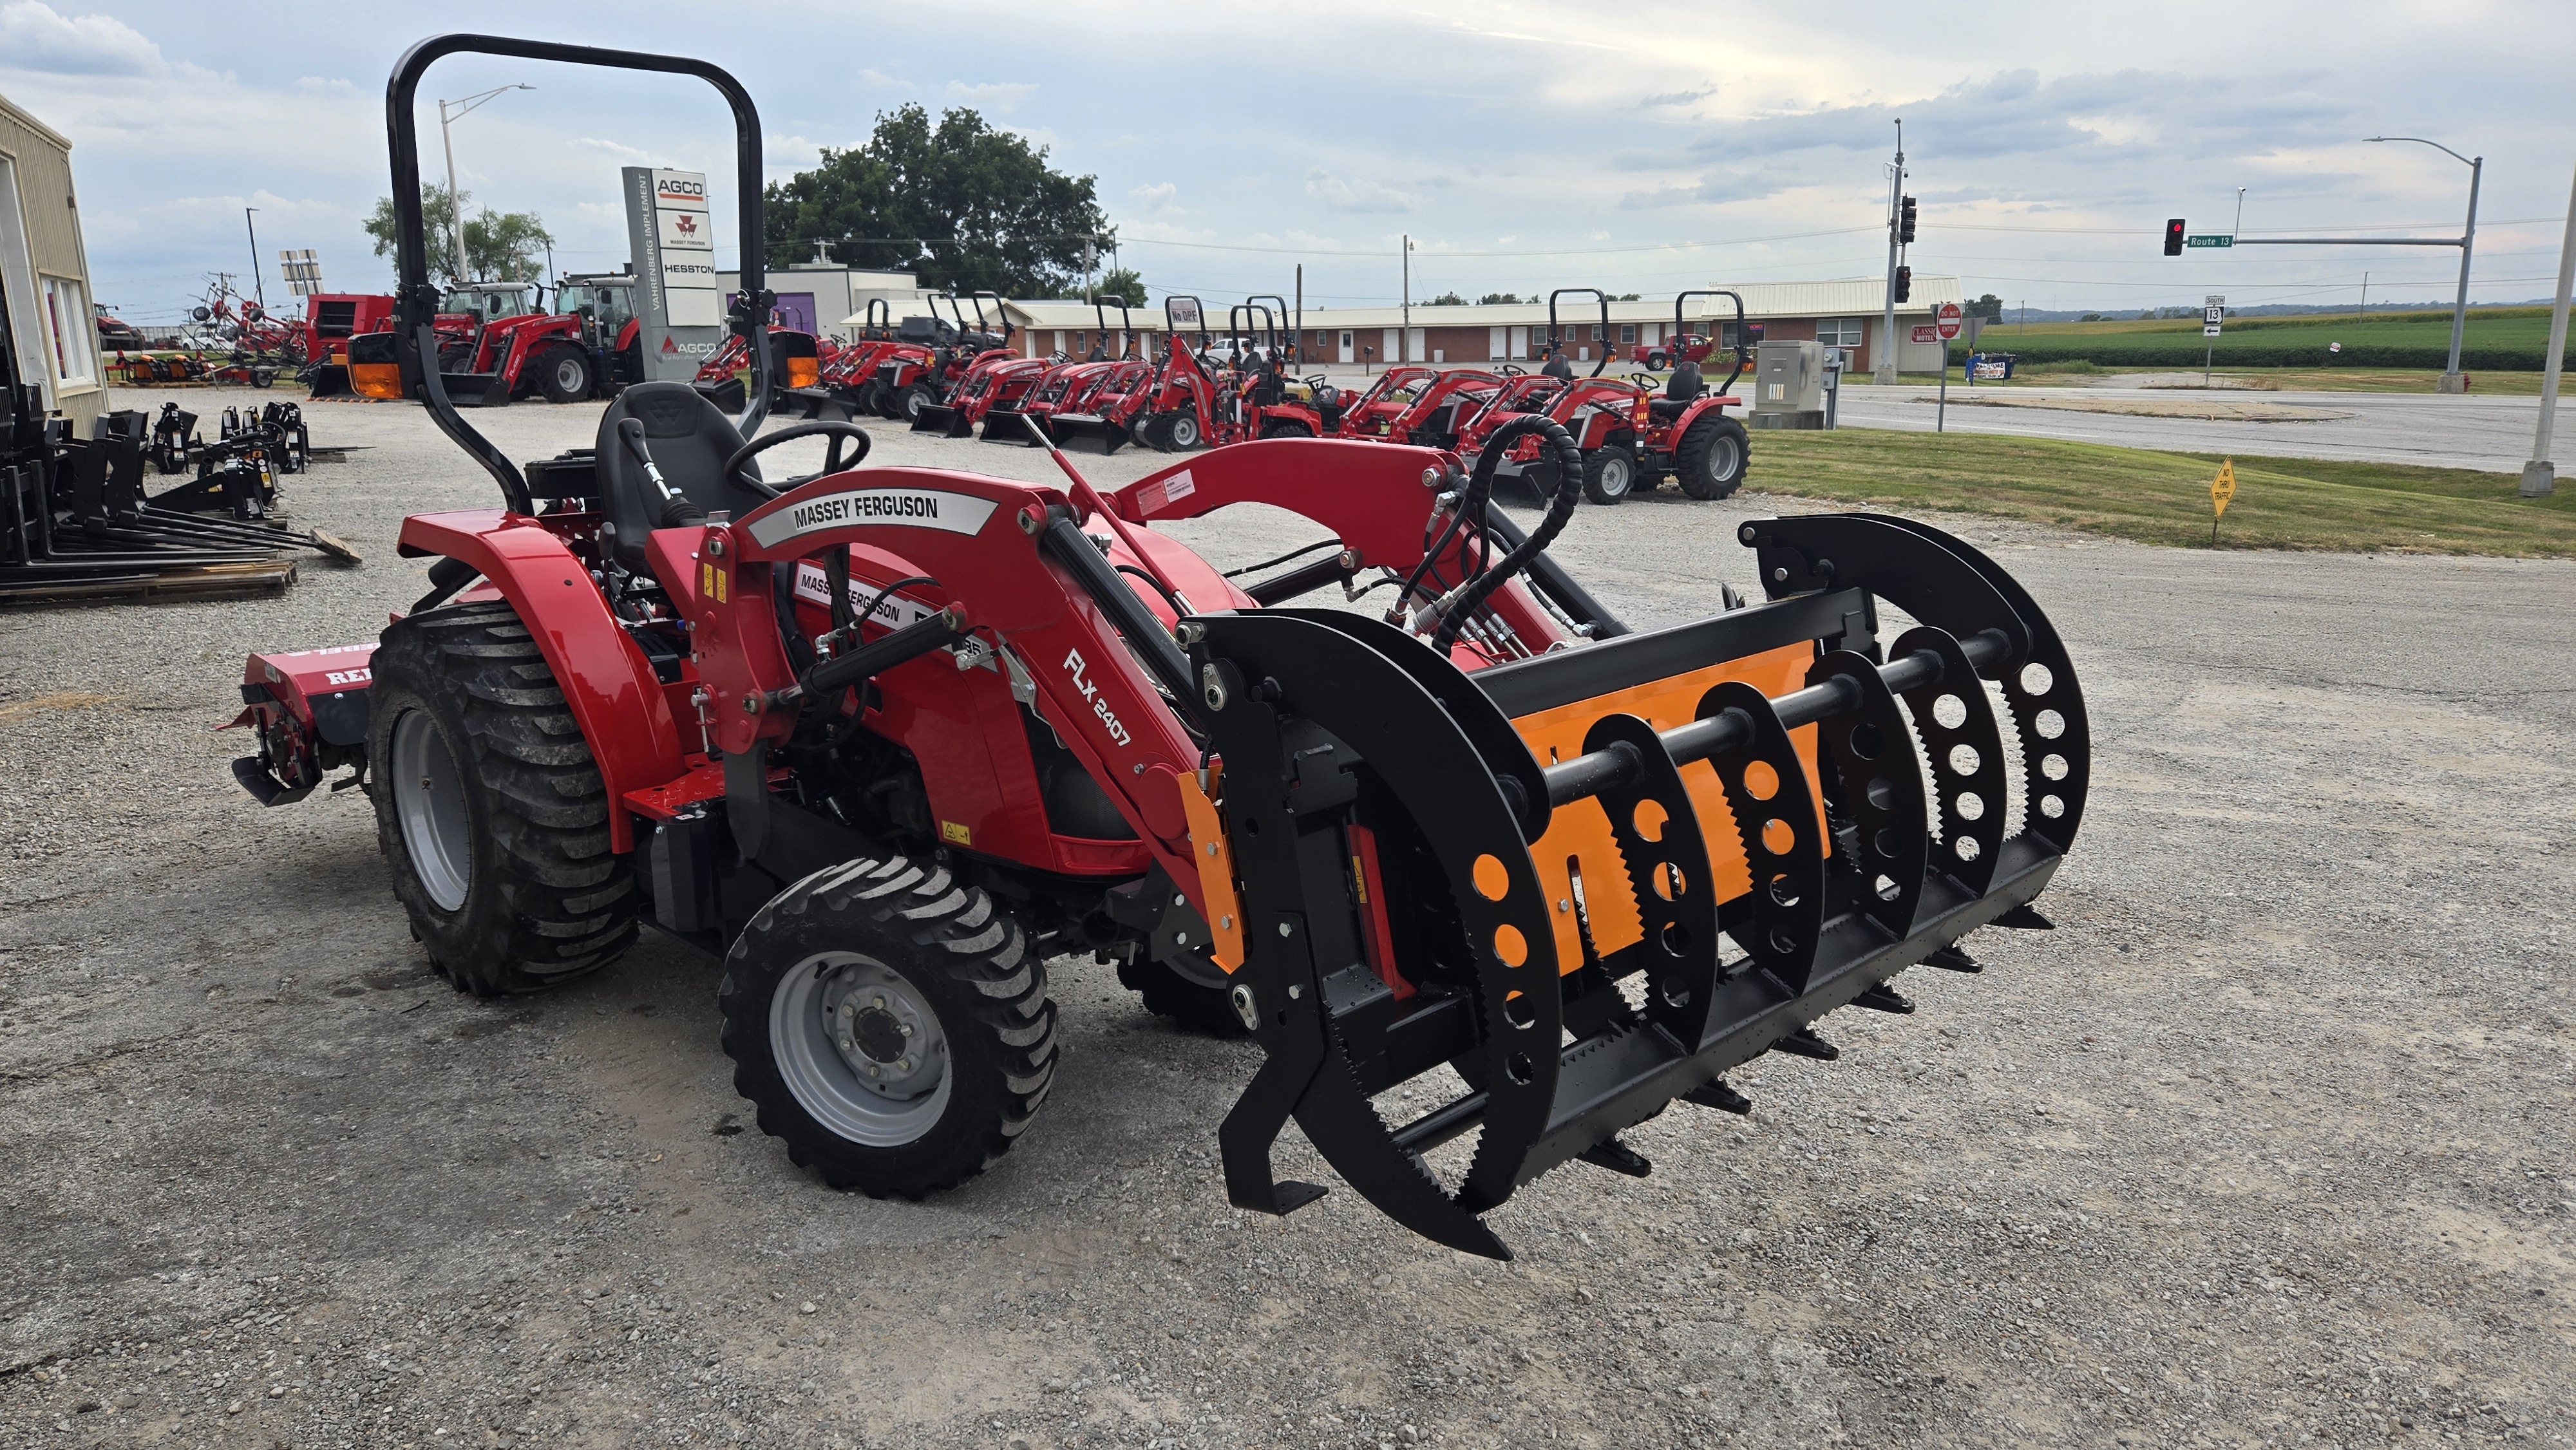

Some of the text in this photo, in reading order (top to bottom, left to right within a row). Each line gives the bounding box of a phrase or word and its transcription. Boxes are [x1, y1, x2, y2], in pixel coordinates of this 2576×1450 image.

[658, 180, 703, 195] AGCO
[638, 173, 660, 310] VAHRENBERG IMPLEMENT
[2221, 237, 2230, 245] 13
[665, 264, 714, 274] HESSTON
[1172, 310, 1197, 321] No DPF
[2210, 309, 2219, 319] 13
[677, 343, 716, 353] AGCO
[2223, 469, 2230, 477] NO
[2219, 480, 2230, 489] THRU
[2215, 492, 2230, 500] TRAFFIC
[794, 496, 938, 529] MASSEY FERGUSON
[800, 574, 830, 595] MASS
[848, 588, 900, 623] ERGSON
[1063, 648, 1131, 747] FLX 2407
